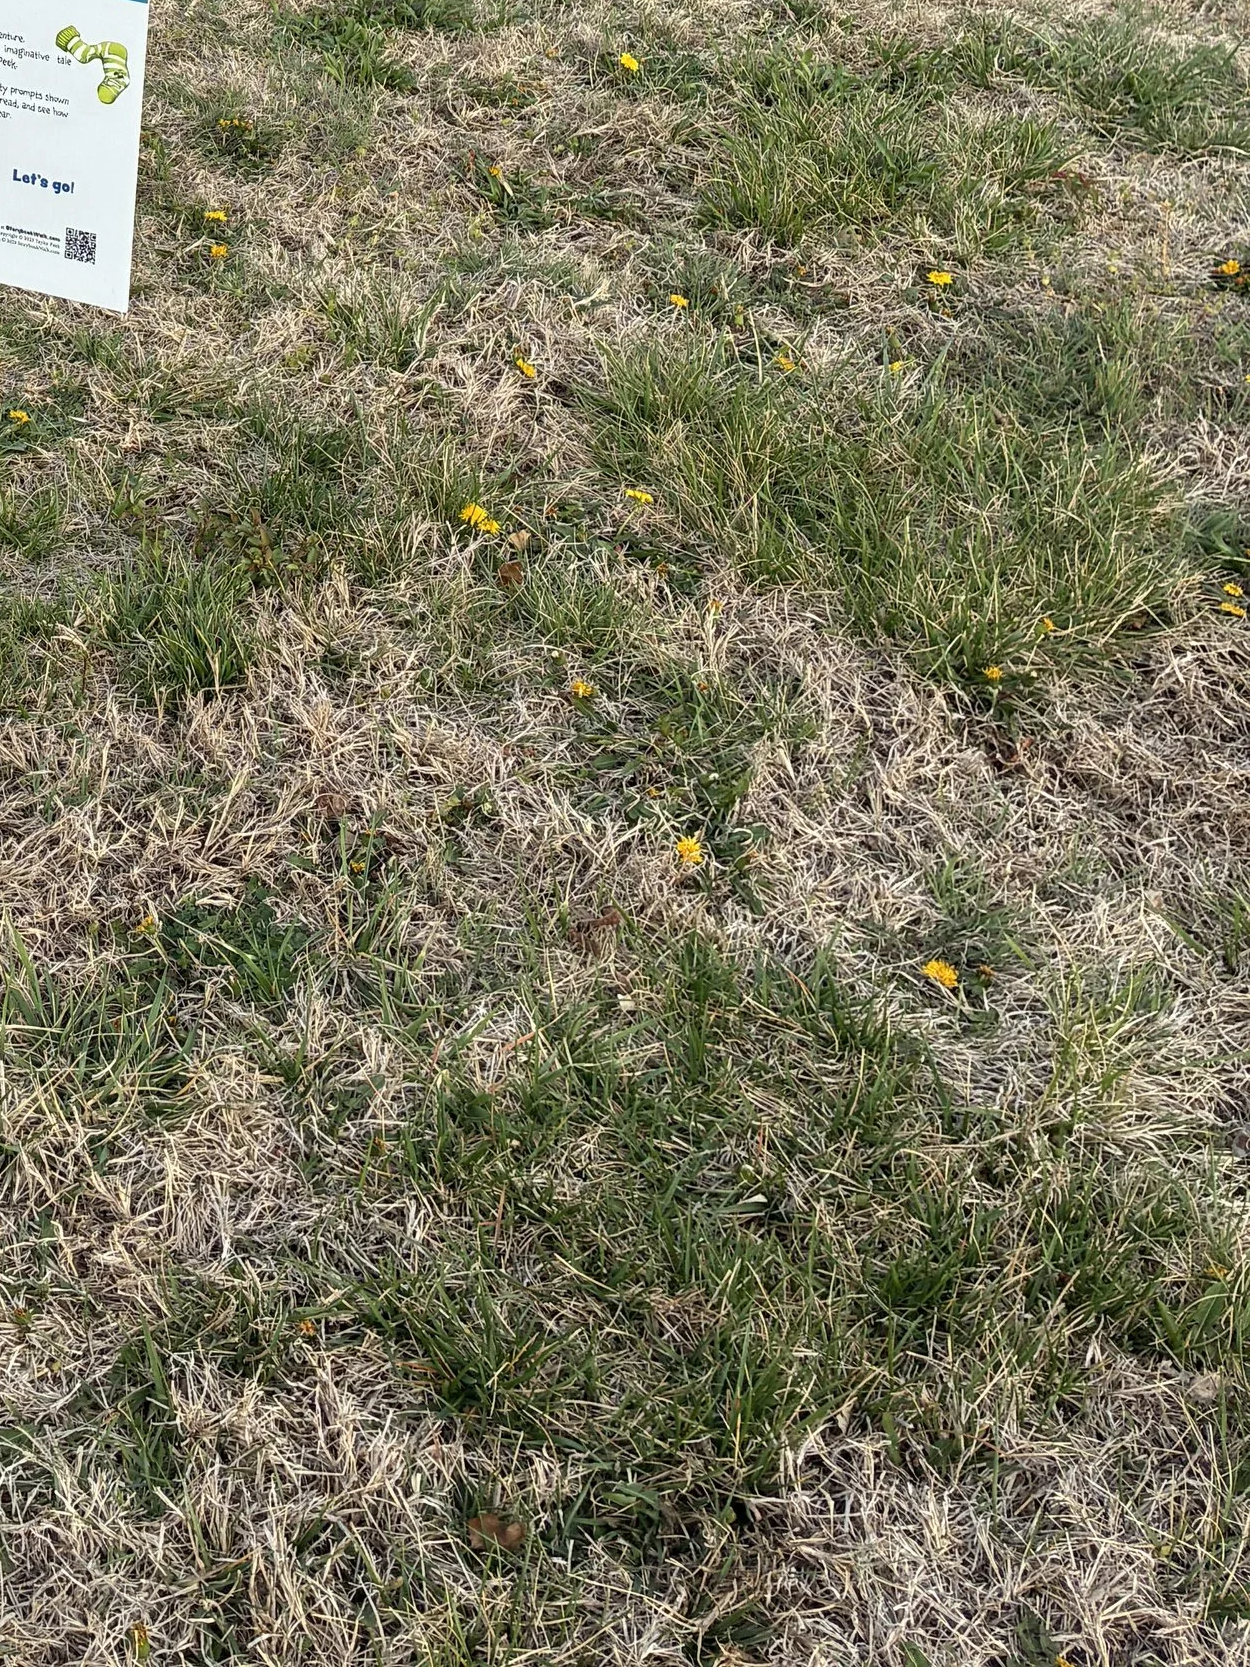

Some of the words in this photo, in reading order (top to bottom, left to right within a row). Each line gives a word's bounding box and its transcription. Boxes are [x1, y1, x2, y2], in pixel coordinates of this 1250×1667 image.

[4, 45, 50, 62] imaginative
[57, 55, 72, 66] tale
[10, 86, 43, 100] prompts
[45, 92, 70, 105] shown
[22, 101, 36, 112] and
[37, 105, 51, 115] see
[53, 106, 69, 118] how
[12, 168, 49, 188] Let's
[52, 181, 75, 194] go!
